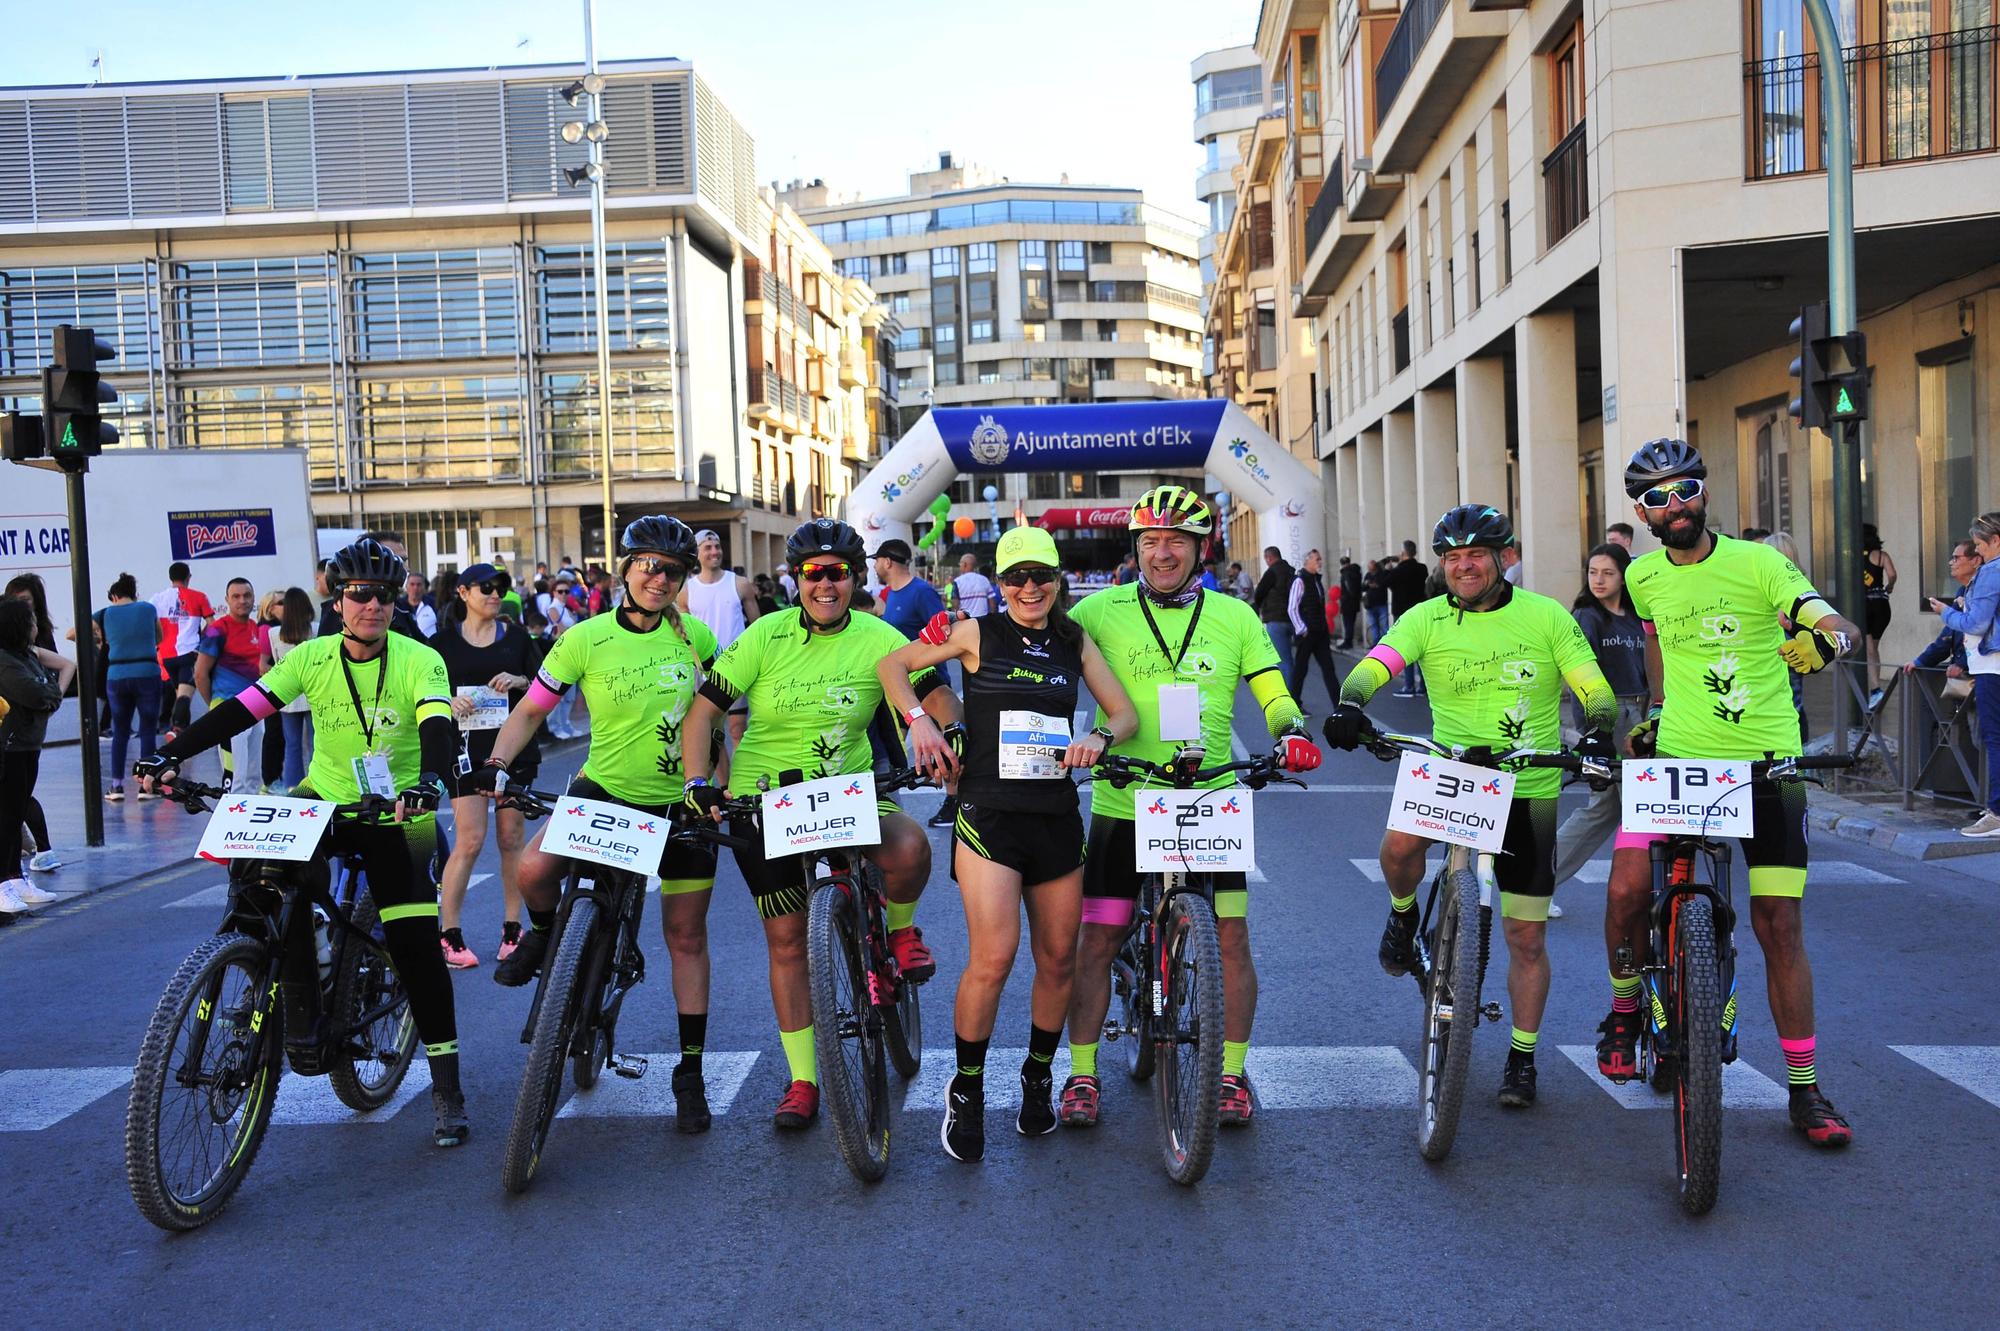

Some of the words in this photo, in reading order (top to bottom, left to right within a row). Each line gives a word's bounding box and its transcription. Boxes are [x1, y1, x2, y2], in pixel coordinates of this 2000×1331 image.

[1014, 428, 1137, 455] Ajuntament
[1142, 425, 1192, 446] d'Elx
[25, 529, 35, 554] A
[39, 528, 70, 554] CAR
[1029, 732, 1047, 743] Afri
[1403, 800, 1495, 831] POSICIÓN
[1687, 819, 1722, 827] ELCHE
[786, 816, 856, 837] MUJER
[1416, 819, 1445, 831] MEDIA
[1447, 826, 1478, 838] ELCHE
[224, 831, 297, 843] MUJER
[568, 832, 640, 856] MUJER
[790, 834, 821, 845] MEDIA
[822, 831, 854, 840] ELCHE
[1149, 834, 1241, 851] POSICIÓN
[255, 844, 288, 852] ELCHE
[569, 843, 600, 855] MEDIA
[601, 850, 633, 862] ELCHE
